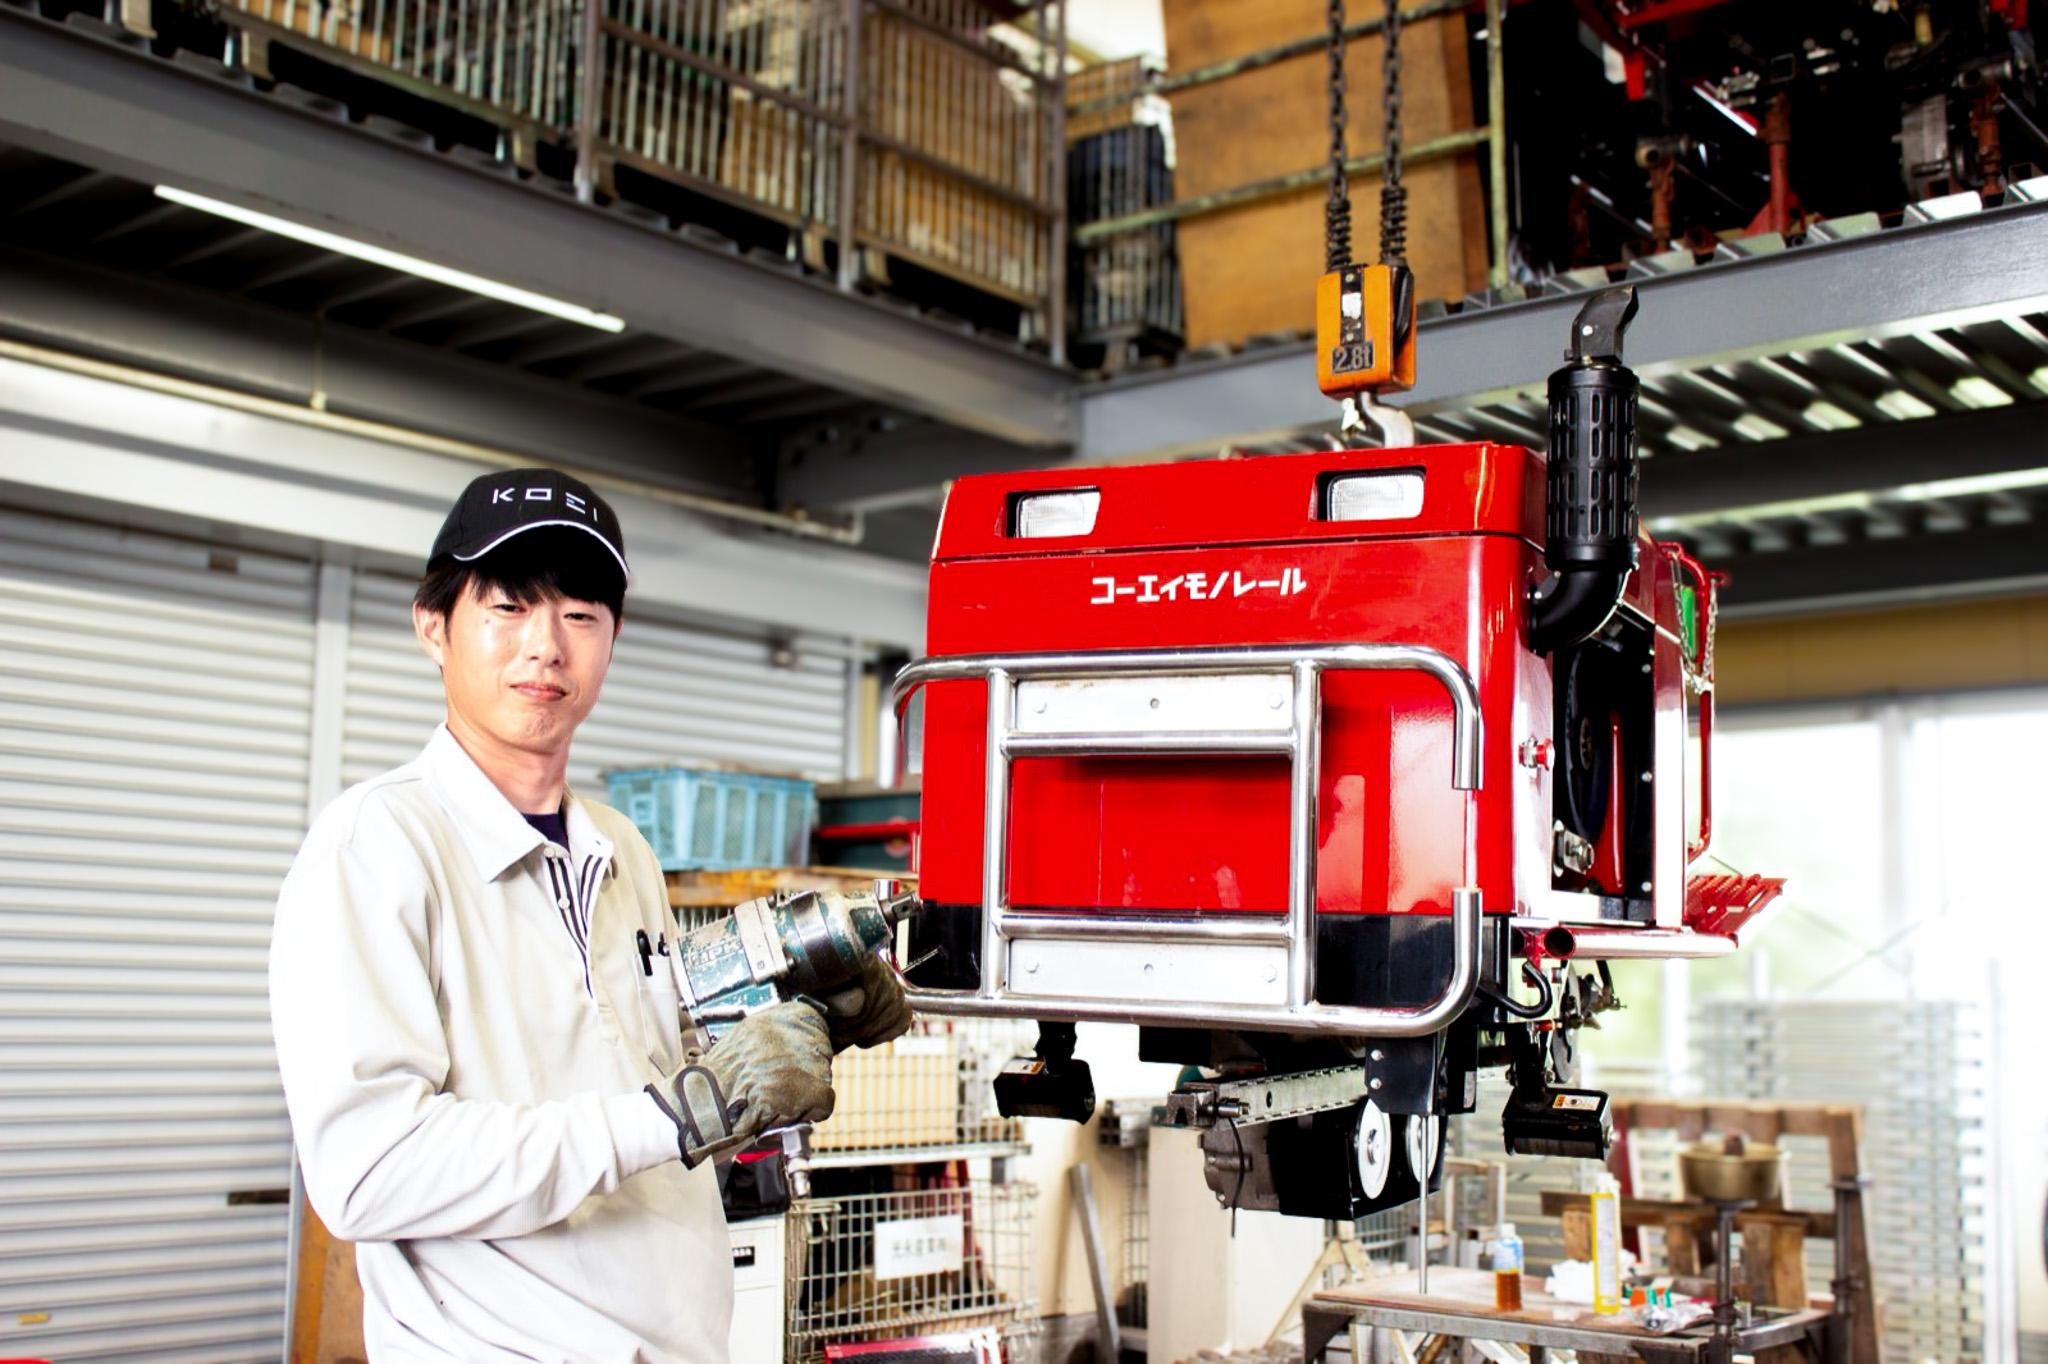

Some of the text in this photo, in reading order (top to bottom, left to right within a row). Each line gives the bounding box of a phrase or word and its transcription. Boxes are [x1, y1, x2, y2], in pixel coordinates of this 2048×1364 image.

[1334, 345, 1371, 372] 2.8t
[1090, 567, 1307, 604] コーエイモノレール
